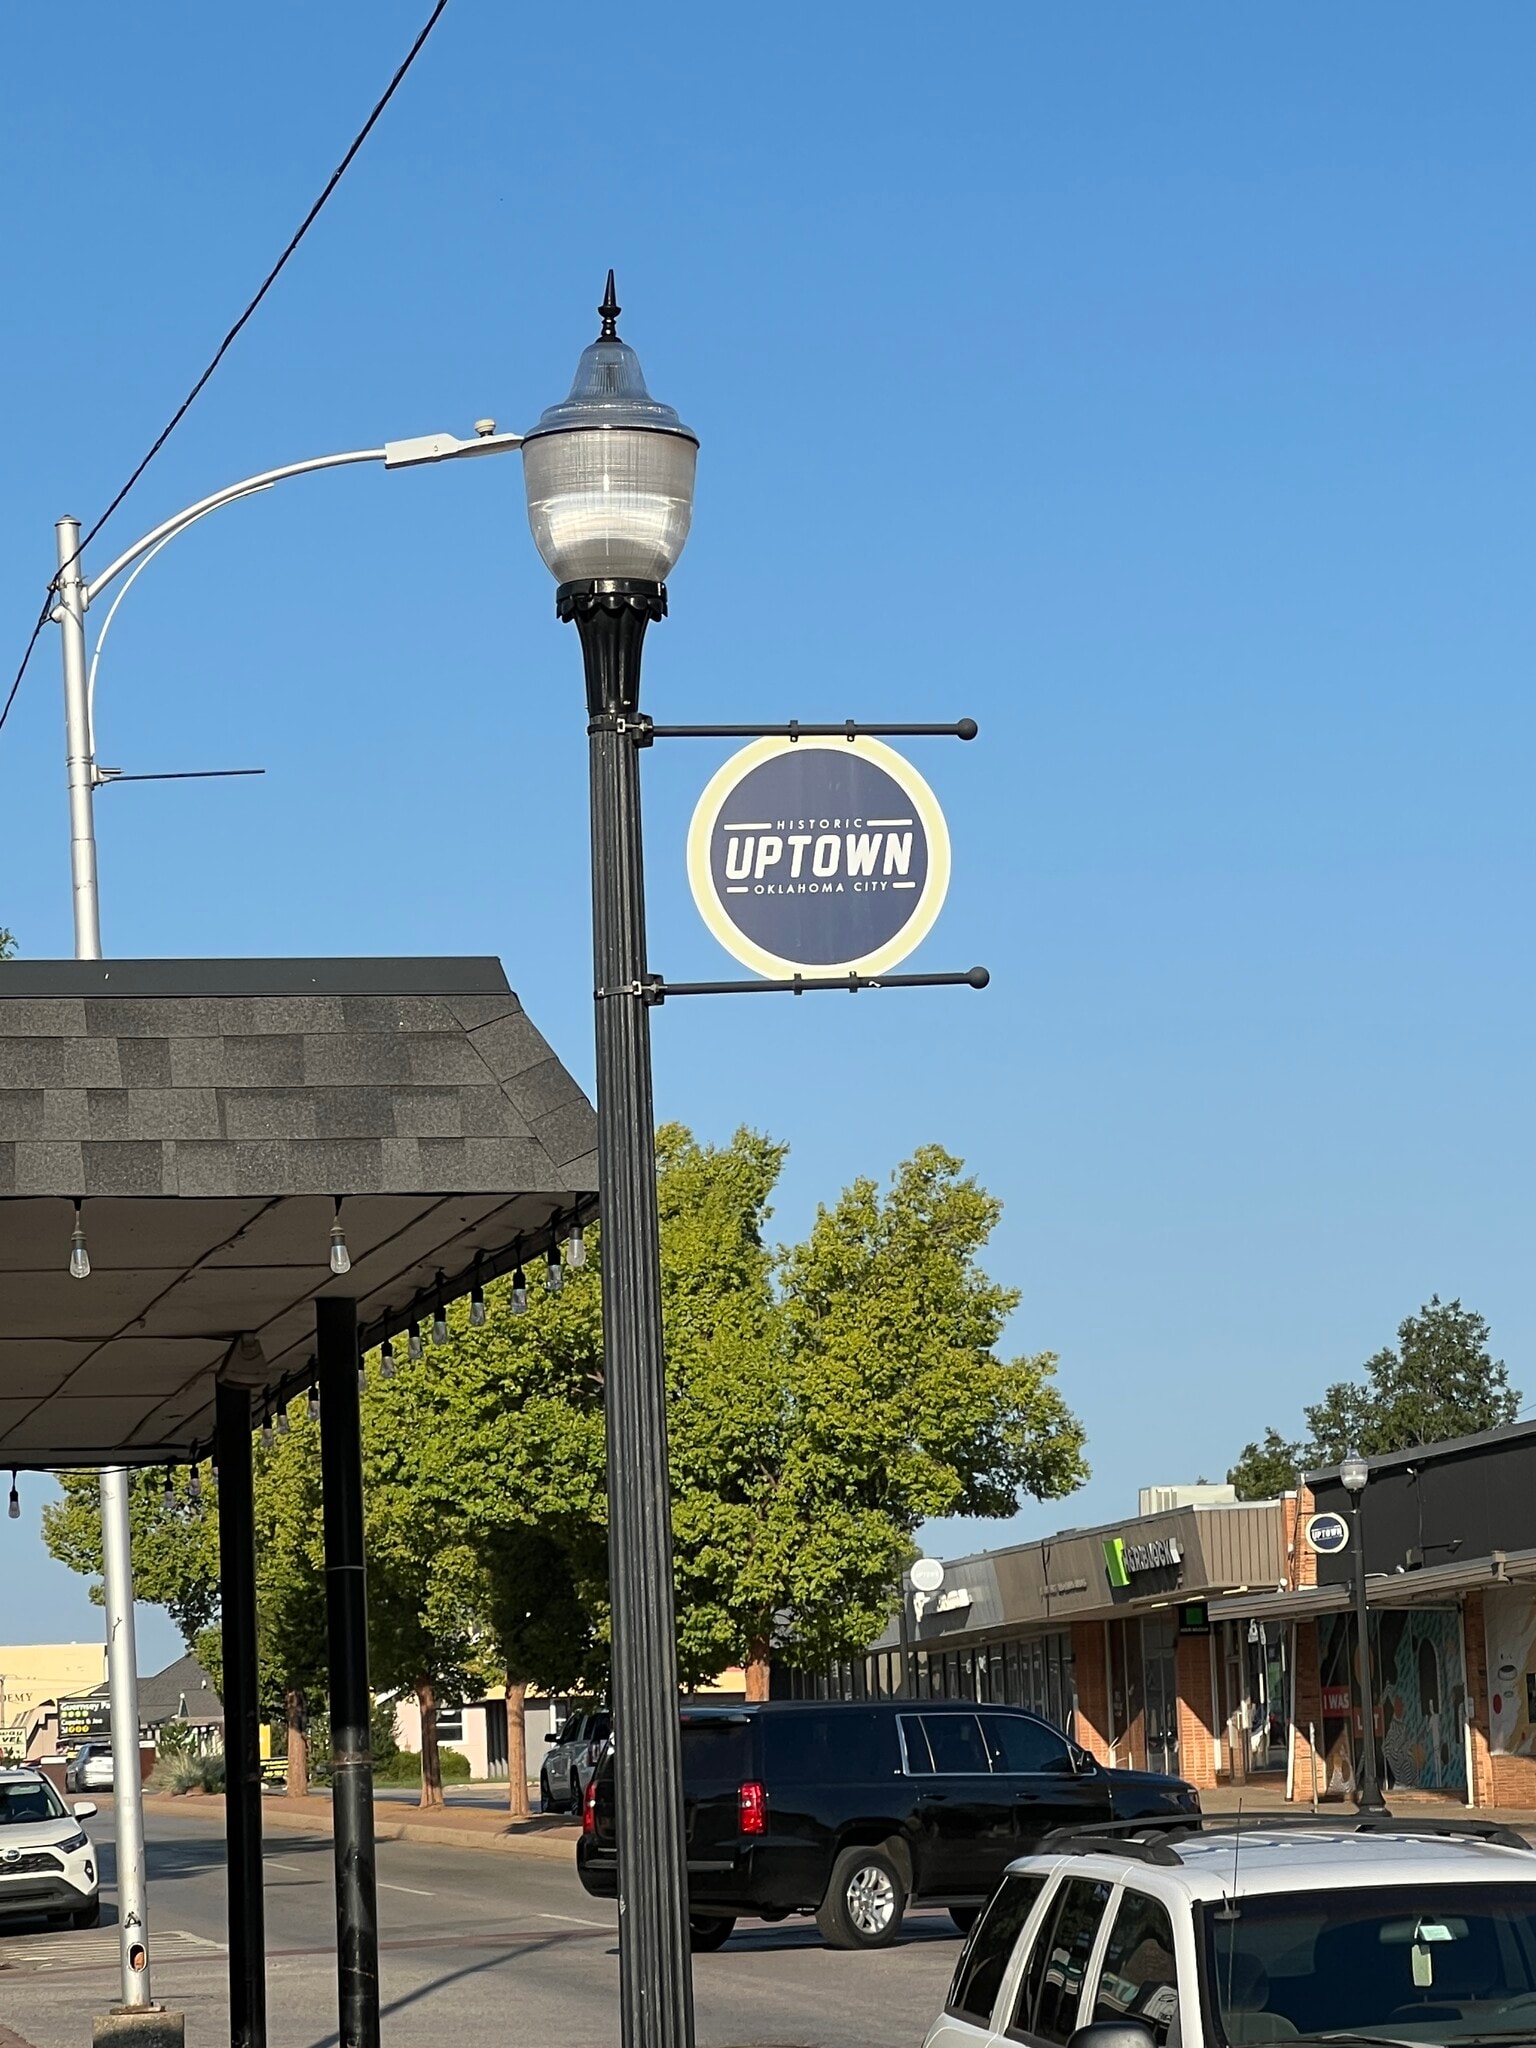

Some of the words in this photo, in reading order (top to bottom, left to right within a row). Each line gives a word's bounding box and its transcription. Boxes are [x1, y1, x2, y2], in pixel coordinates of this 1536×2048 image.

[776, 818, 863, 830] HISTORIC
[725, 832, 913, 880] UPTOWN
[754, 882, 845, 895] OKLAHOMA
[853, 881, 888, 892] CITY
[1311, 1527, 1343, 1540] UPTOWN
[1323, 1694, 1328, 1710] I
[1328, 1692, 1350, 1710] WAS
